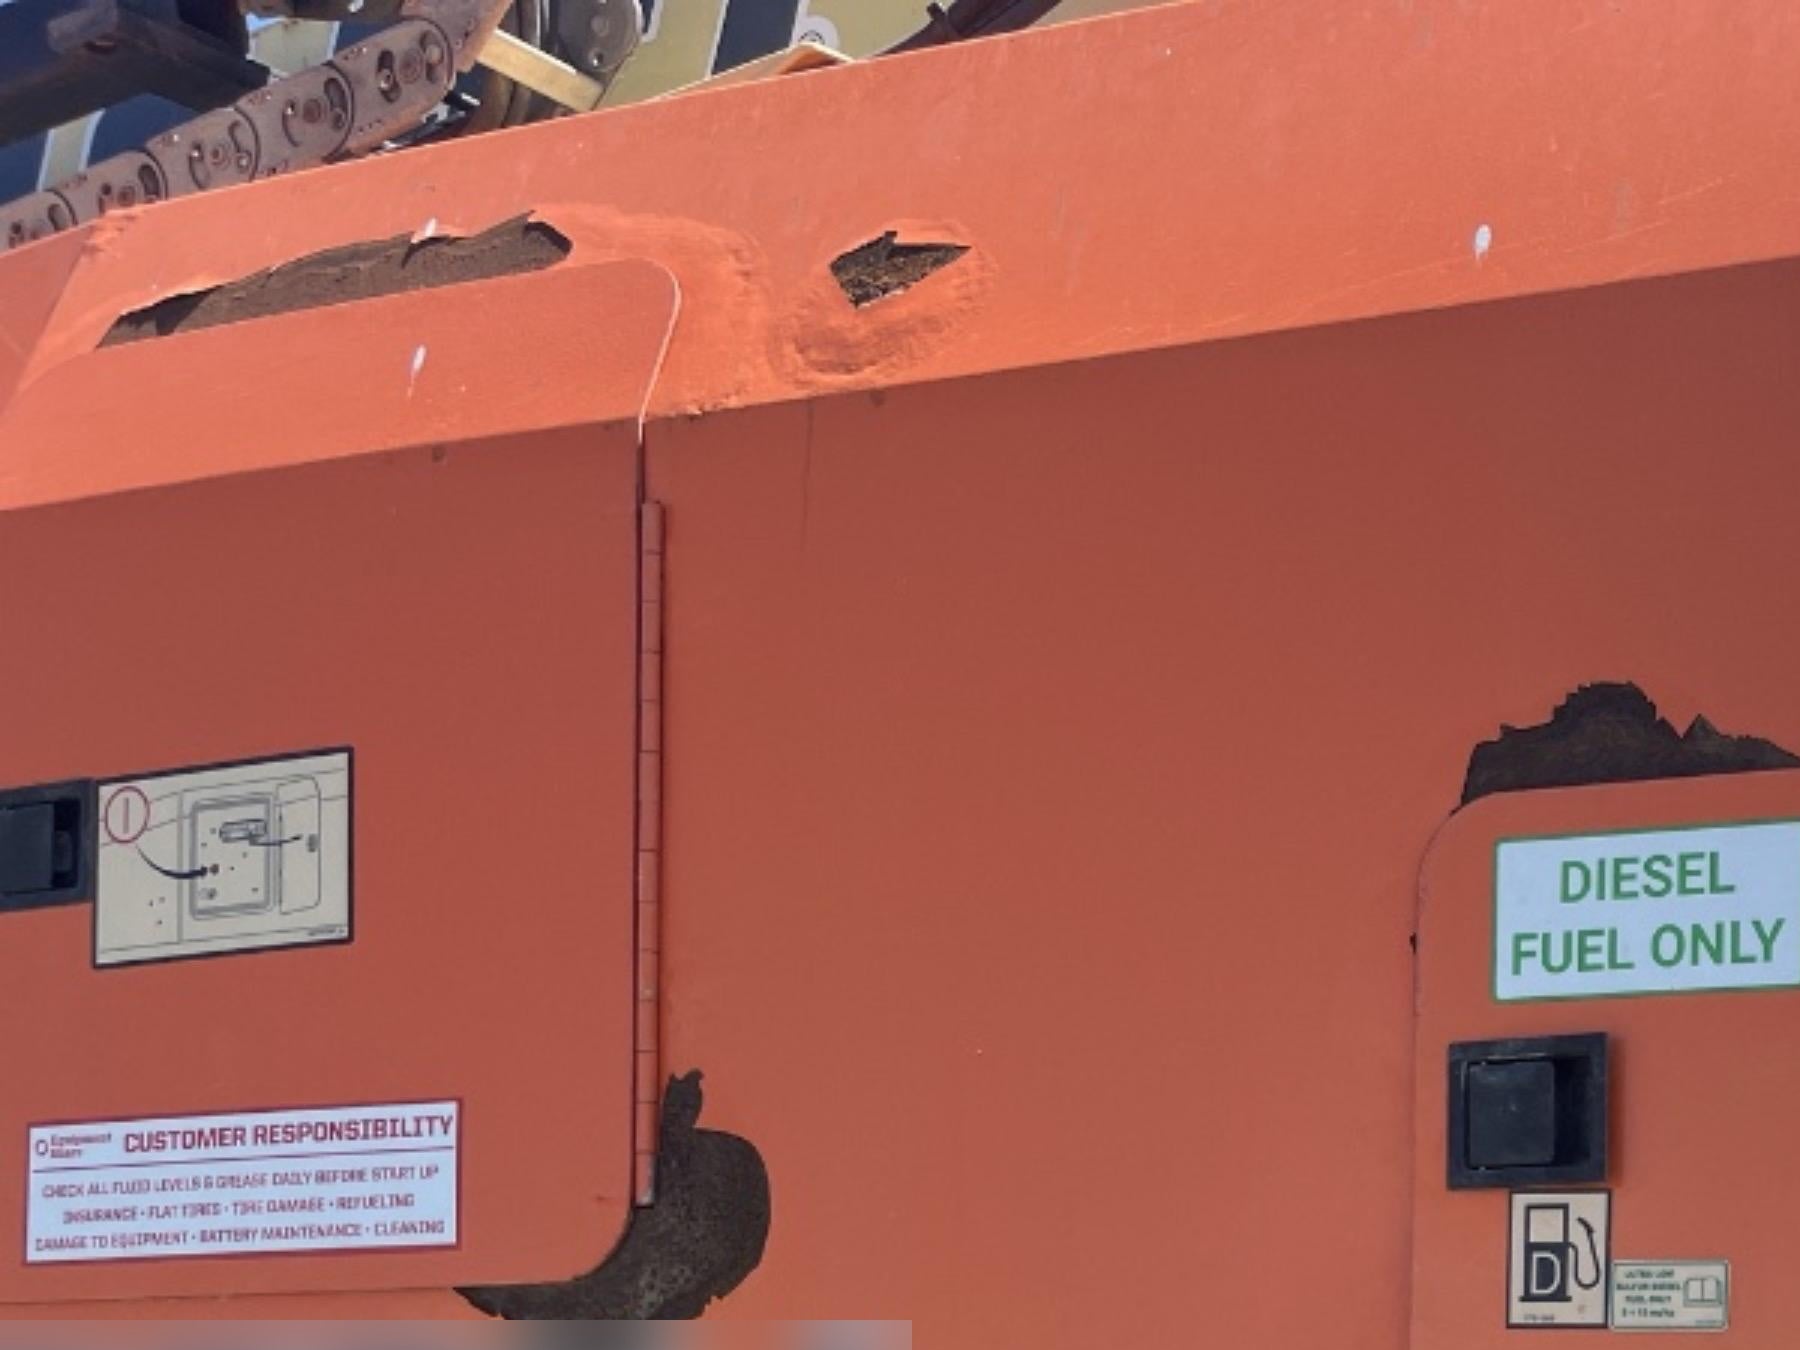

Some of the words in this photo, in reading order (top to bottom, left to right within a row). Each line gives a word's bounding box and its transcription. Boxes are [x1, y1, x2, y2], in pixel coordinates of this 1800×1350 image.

[1559, 850, 1736, 904] DIESEL
[1510, 926, 1636, 977] FUEL
[1650, 916, 1786, 968] ONLY
[124, 1126, 247, 1154] CUSTOMER
[253, 1114, 454, 1146] RESPONSIBILITY
[1529, 1251, 1562, 1295] D
